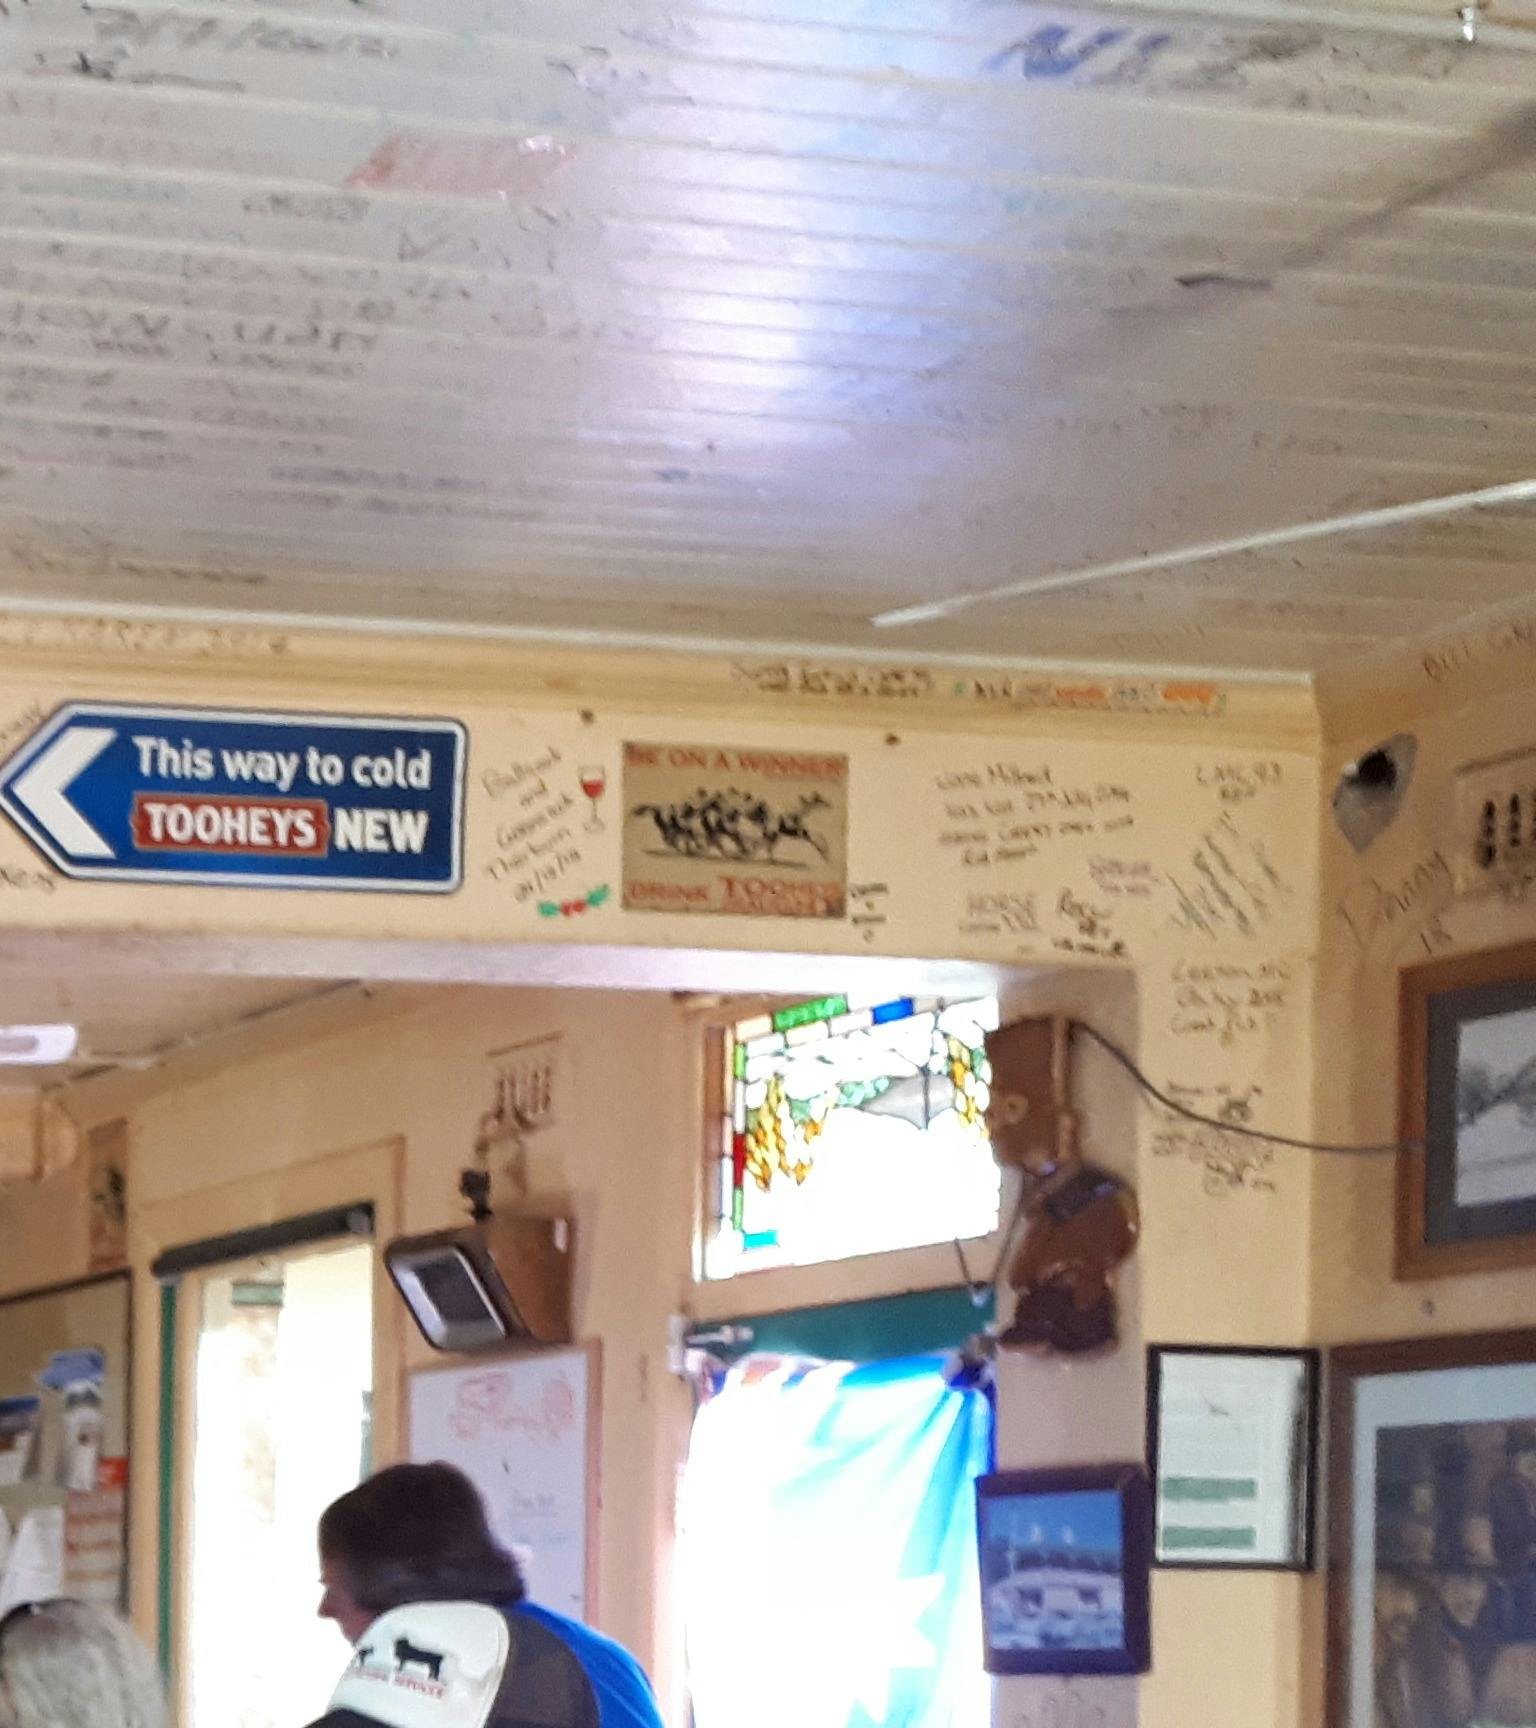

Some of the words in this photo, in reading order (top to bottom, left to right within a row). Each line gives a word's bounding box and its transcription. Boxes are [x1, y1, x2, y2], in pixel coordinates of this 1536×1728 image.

[132, 735, 215, 781] This
[221, 748, 299, 792] way
[306, 749, 344, 783] to
[351, 751, 432, 791] cold
[668, 748, 707, 769] ON
[715, 750, 730, 770] A
[144, 802, 319, 849] TOOHEYS
[332, 808, 428, 854] NEW
